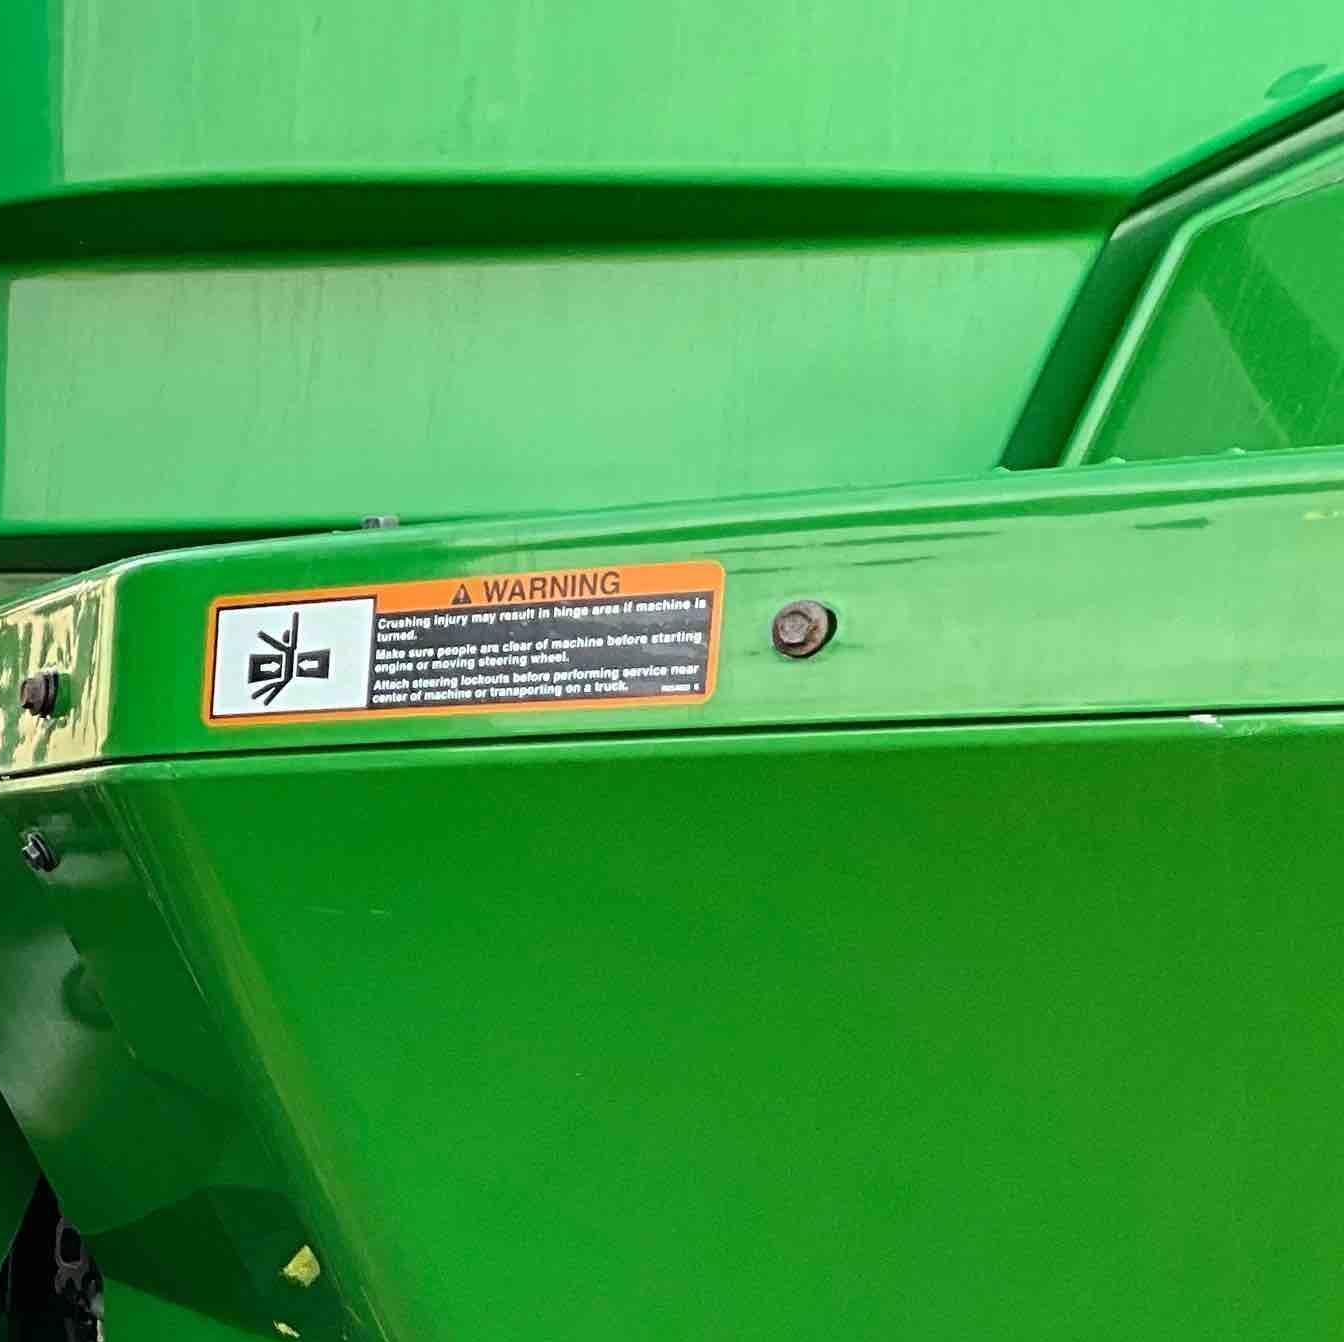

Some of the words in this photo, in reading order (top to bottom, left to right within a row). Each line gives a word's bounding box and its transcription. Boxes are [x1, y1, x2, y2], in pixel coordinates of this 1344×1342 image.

[483, 571, 620, 603] WARNING
[378, 614, 431, 630] Crushing
[433, 612, 467, 627] injury
[471, 612, 496, 625] may
[499, 607, 535, 622] result
[538, 608, 550, 619] in
[553, 604, 589, 618] hinge
[591, 604, 620, 615] area
[623, 601, 634, 614] if
[636, 599, 691, 613] machine
[694, 597, 707, 609] is
[376, 648, 406, 660] Make
[408, 647, 435, 658] sure
[437, 644, 477, 659] people
[480, 644, 499, 654] are
[502, 641, 532, 652] clear
[535, 639, 550, 650] of
[551, 637, 604, 649] machine
[607, 633, 648, 647] before
[651, 630, 703, 645] starting
[377, 630, 418, 642] turned.
[374, 659, 413, 675] engine
[416, 661, 429, 671] or
[431, 657, 475, 671] moving
[478, 653, 528, 668] steering
[530, 651, 569, 664] wheel.
[373, 678, 410, 691] Attach
[412, 674, 458, 689] steering
[460, 673, 510, 686] lockouts
[513, 671, 550, 684] before
[553, 667, 620, 684] performing
[622, 665, 668, 677] service
[670, 664, 700, 676] near
[372, 692, 407, 704] center
[410, 690, 422, 701] of
[424, 688, 473, 701] machine
[475, 688, 487, 698] or
[489, 683, 562, 699] transporting
[565, 683, 581, 693] on
[583, 683, 592, 693] a
[594, 680, 629, 692] truck.
